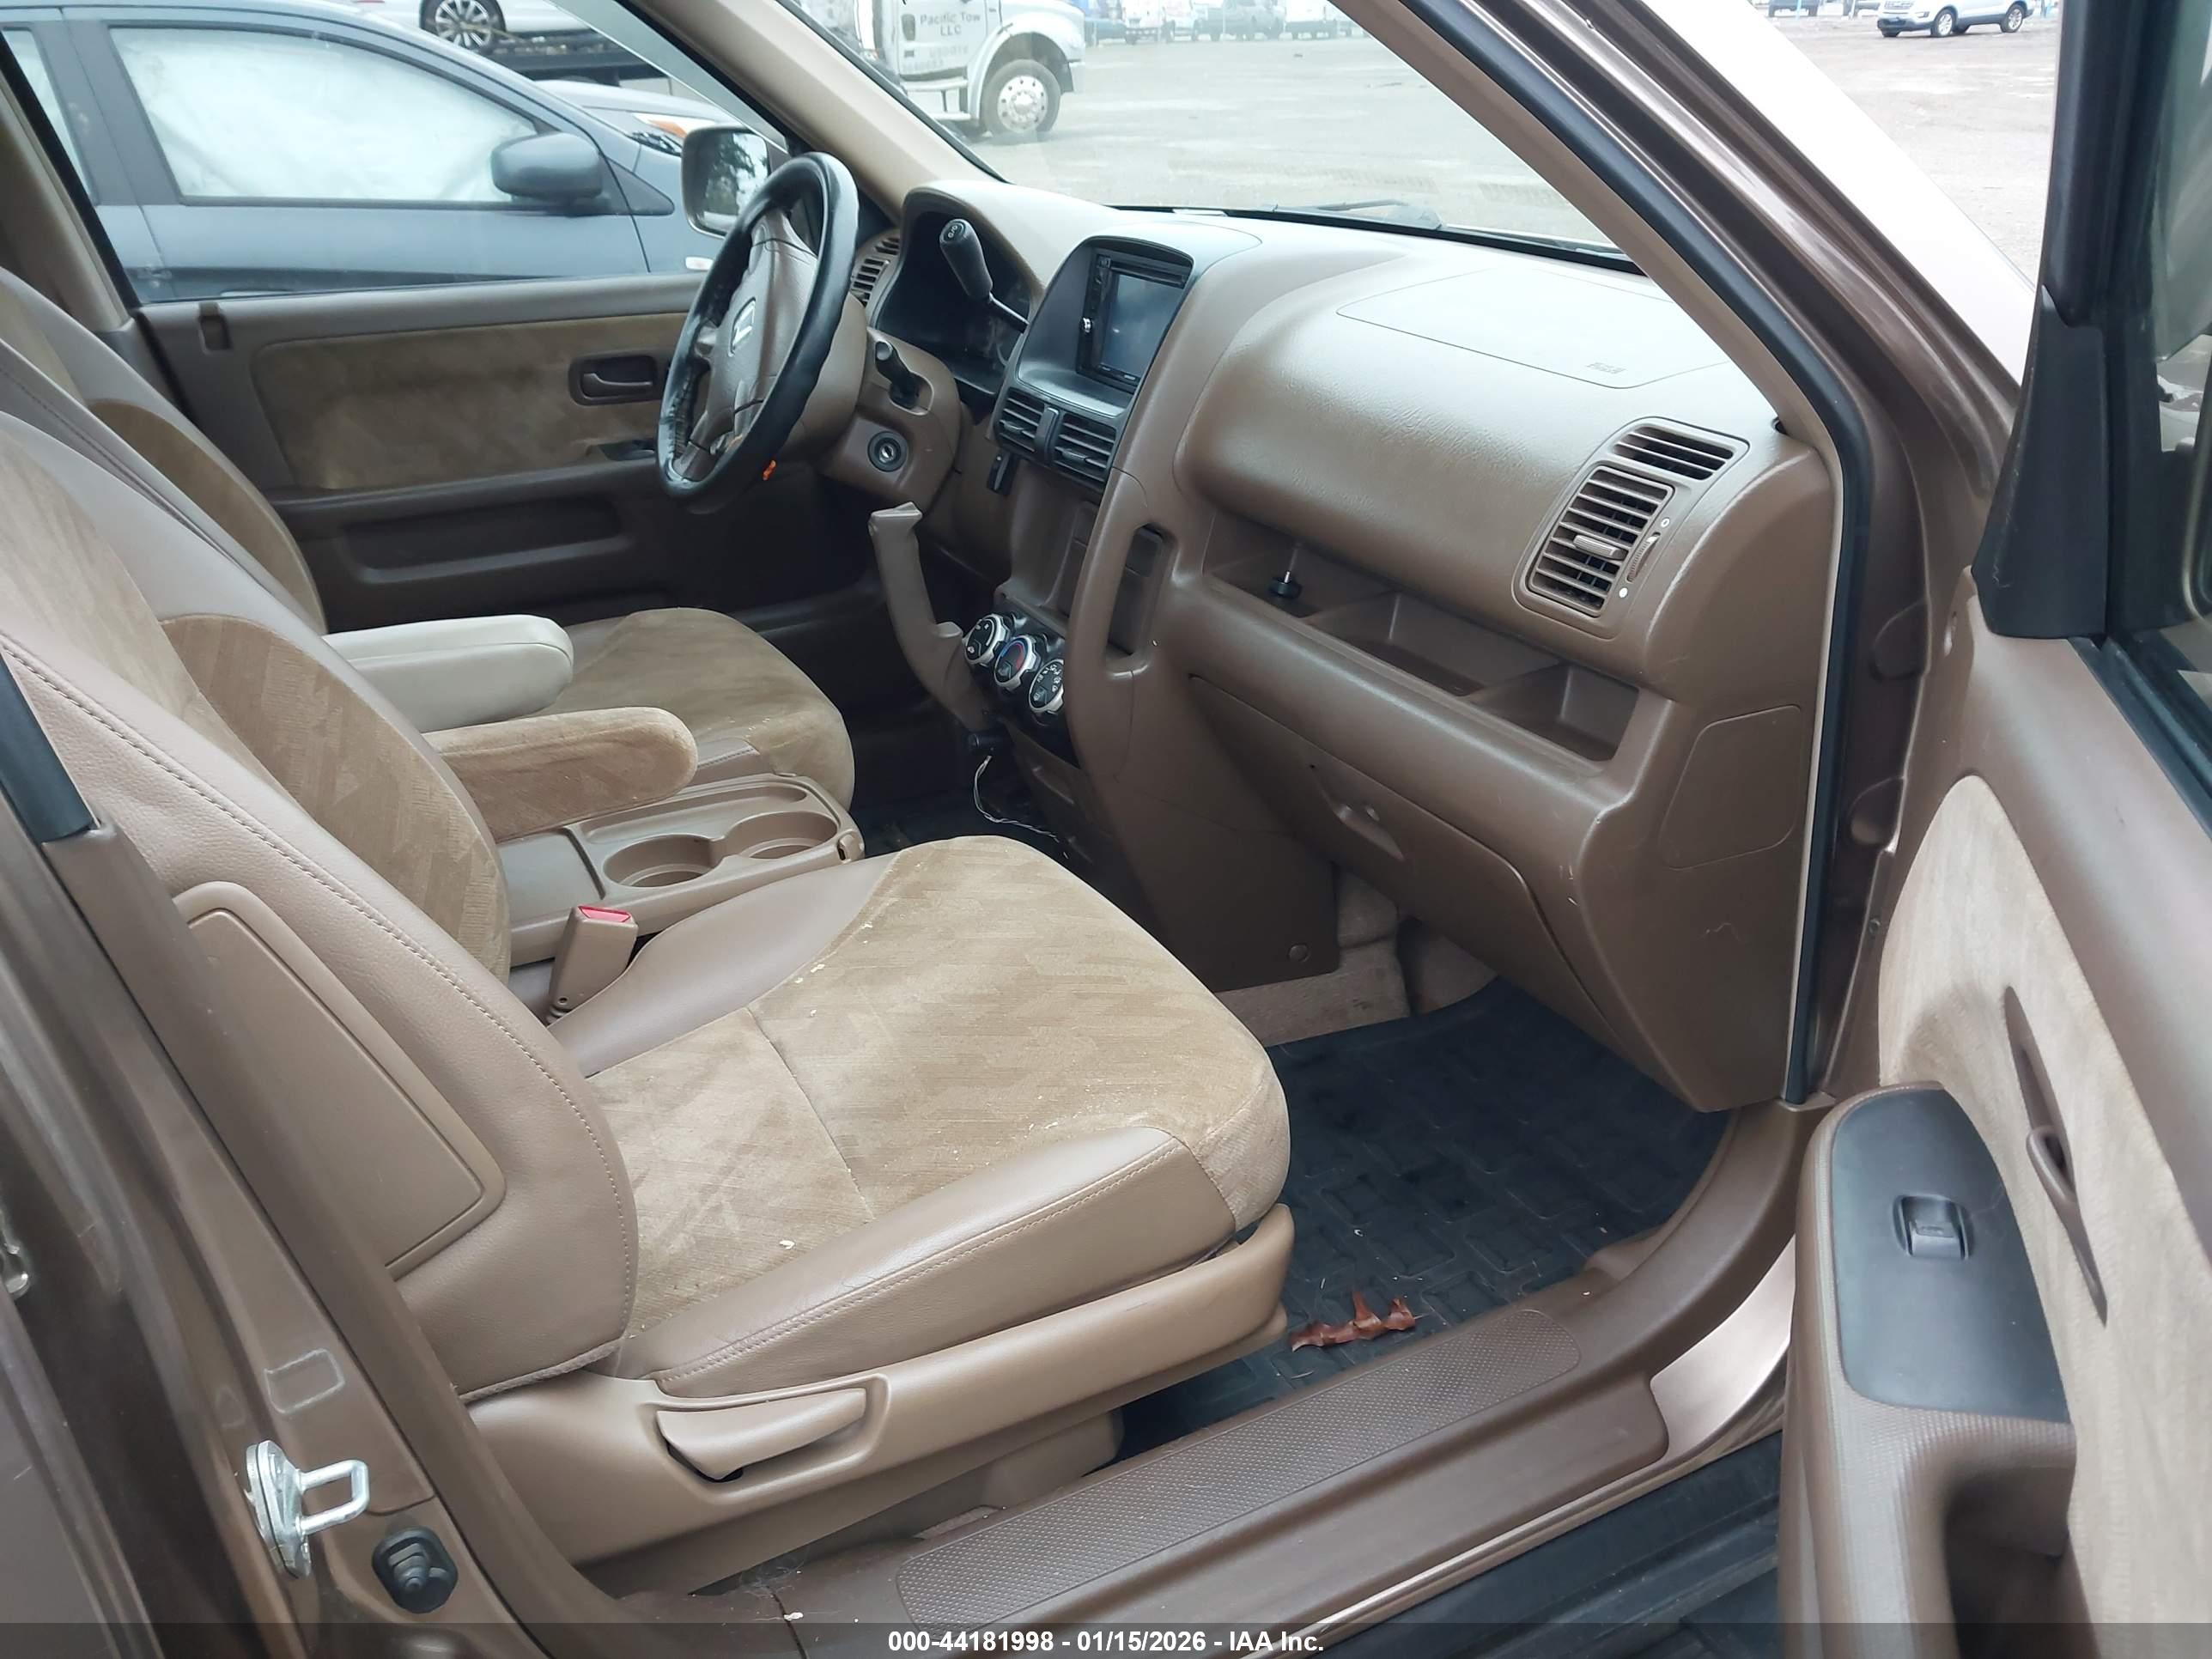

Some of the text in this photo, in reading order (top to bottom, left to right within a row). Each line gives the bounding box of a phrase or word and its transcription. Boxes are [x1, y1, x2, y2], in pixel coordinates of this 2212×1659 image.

[920, 11, 981, 25] Pacific Tow
[940, 24, 962, 36] LLC
